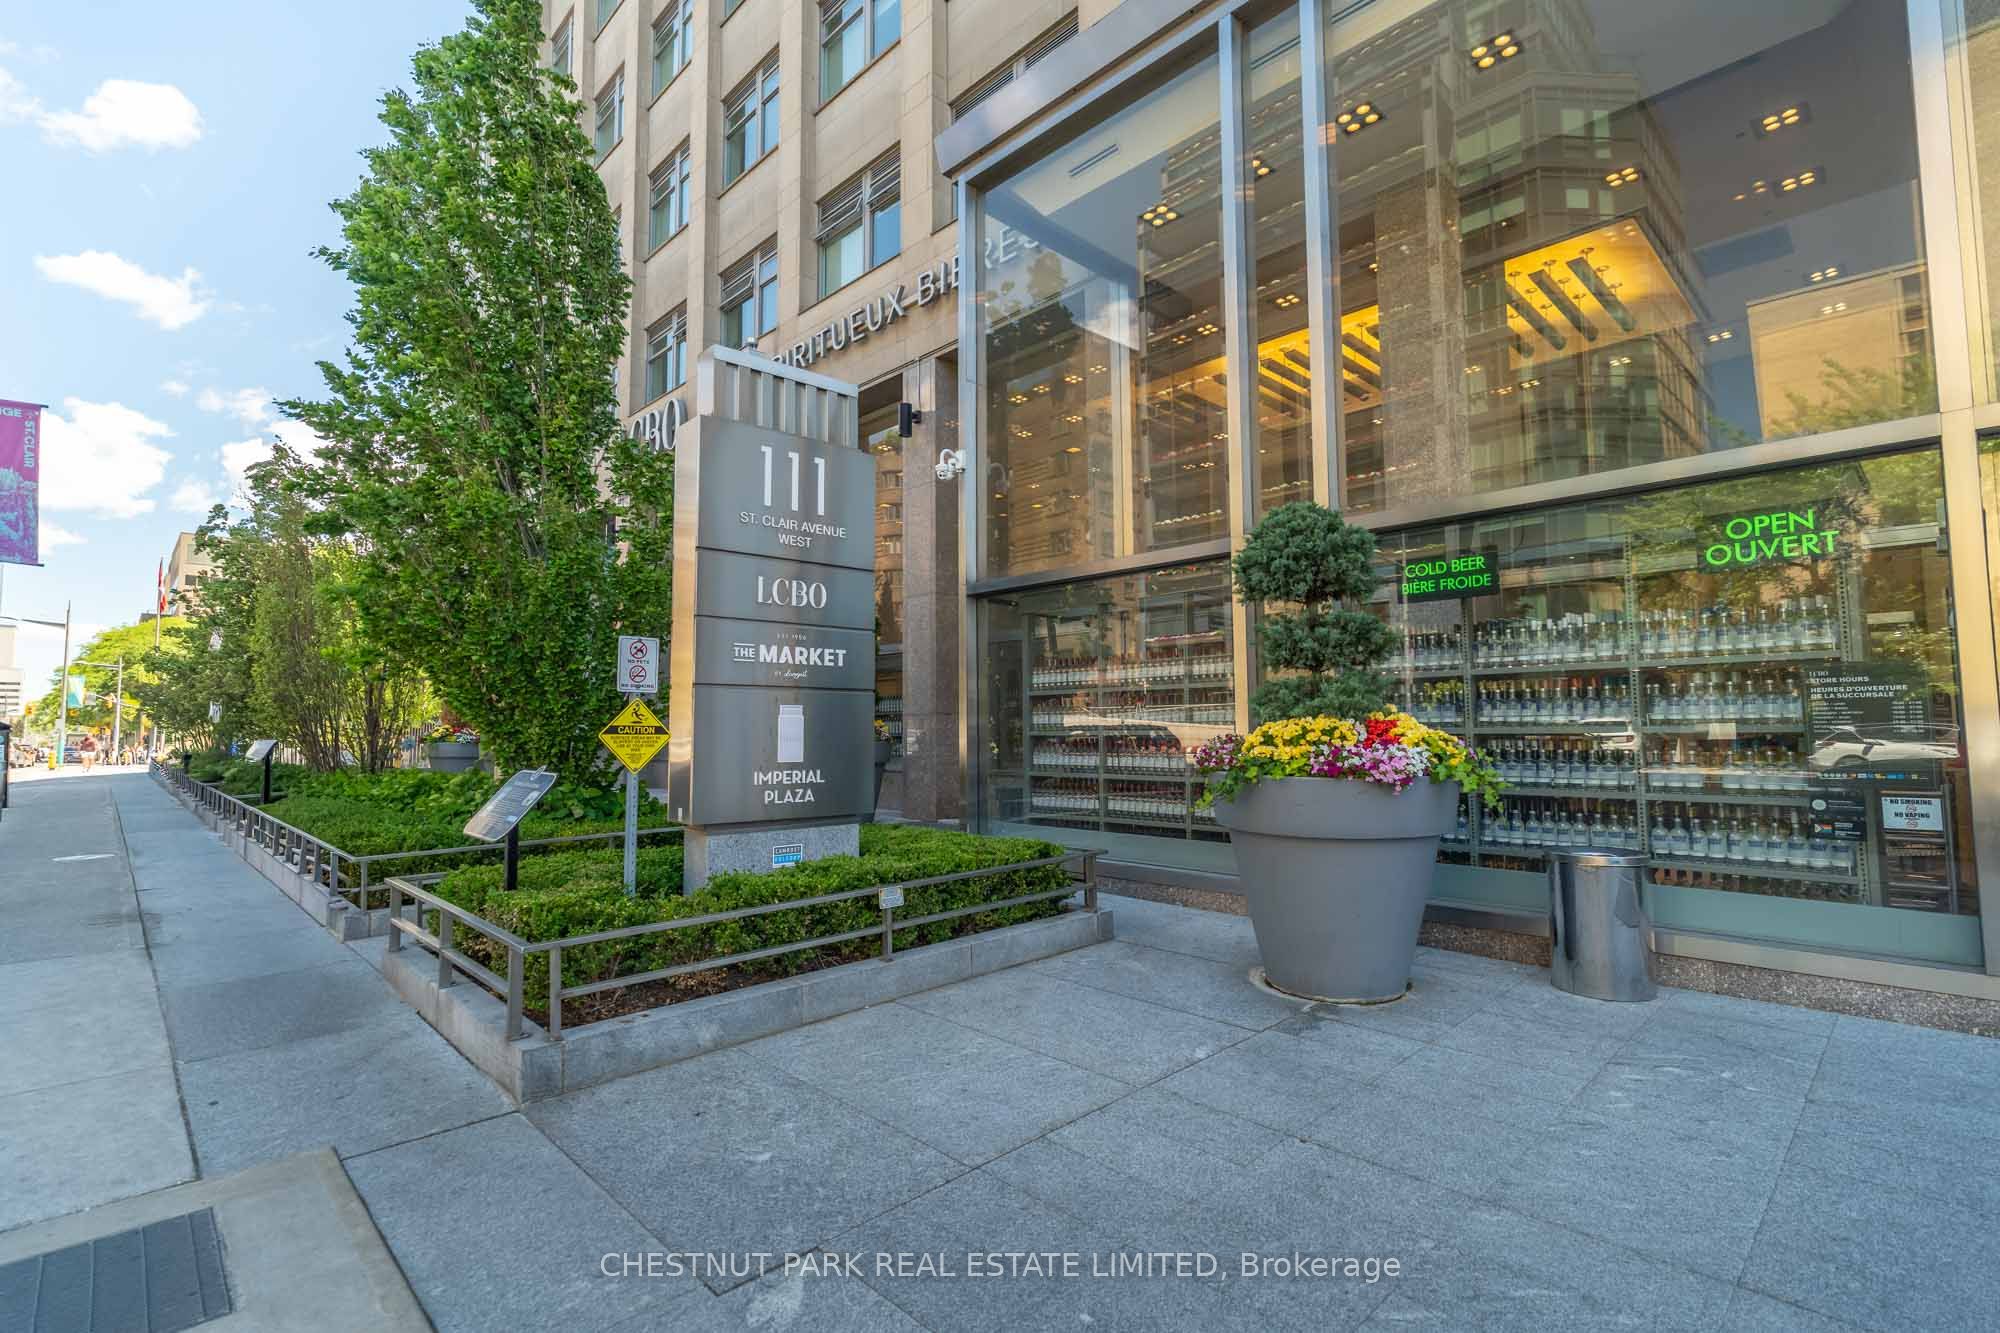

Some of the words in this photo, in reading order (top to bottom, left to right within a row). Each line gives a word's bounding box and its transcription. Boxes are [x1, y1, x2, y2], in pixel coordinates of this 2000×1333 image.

[761, 445, 825, 516] 111
[740, 511, 759, 525] ST.
[762, 514, 799, 531] CLAIR
[800, 520, 847, 539] AVENUE
[1725, 508, 1816, 540] OPEN
[778, 533, 813, 549] WEST
[1705, 530, 1841, 566] OUVERT
[1405, 561, 1448, 578] COLD
[1451, 556, 1486, 573] BEER
[757, 575, 827, 609] LCBO
[1402, 578, 1437, 596] BIÈRE
[1440, 573, 1492, 592] FROIDE
[733, 646, 756, 658] THE
[759, 643, 847, 668] MARKET
[1846, 684, 1909, 692] D'OUVERTURE
[617, 726, 656, 734] CAUTION
[754, 769, 825, 785] IMPERIAL
[764, 789, 815, 804] PLAZA
